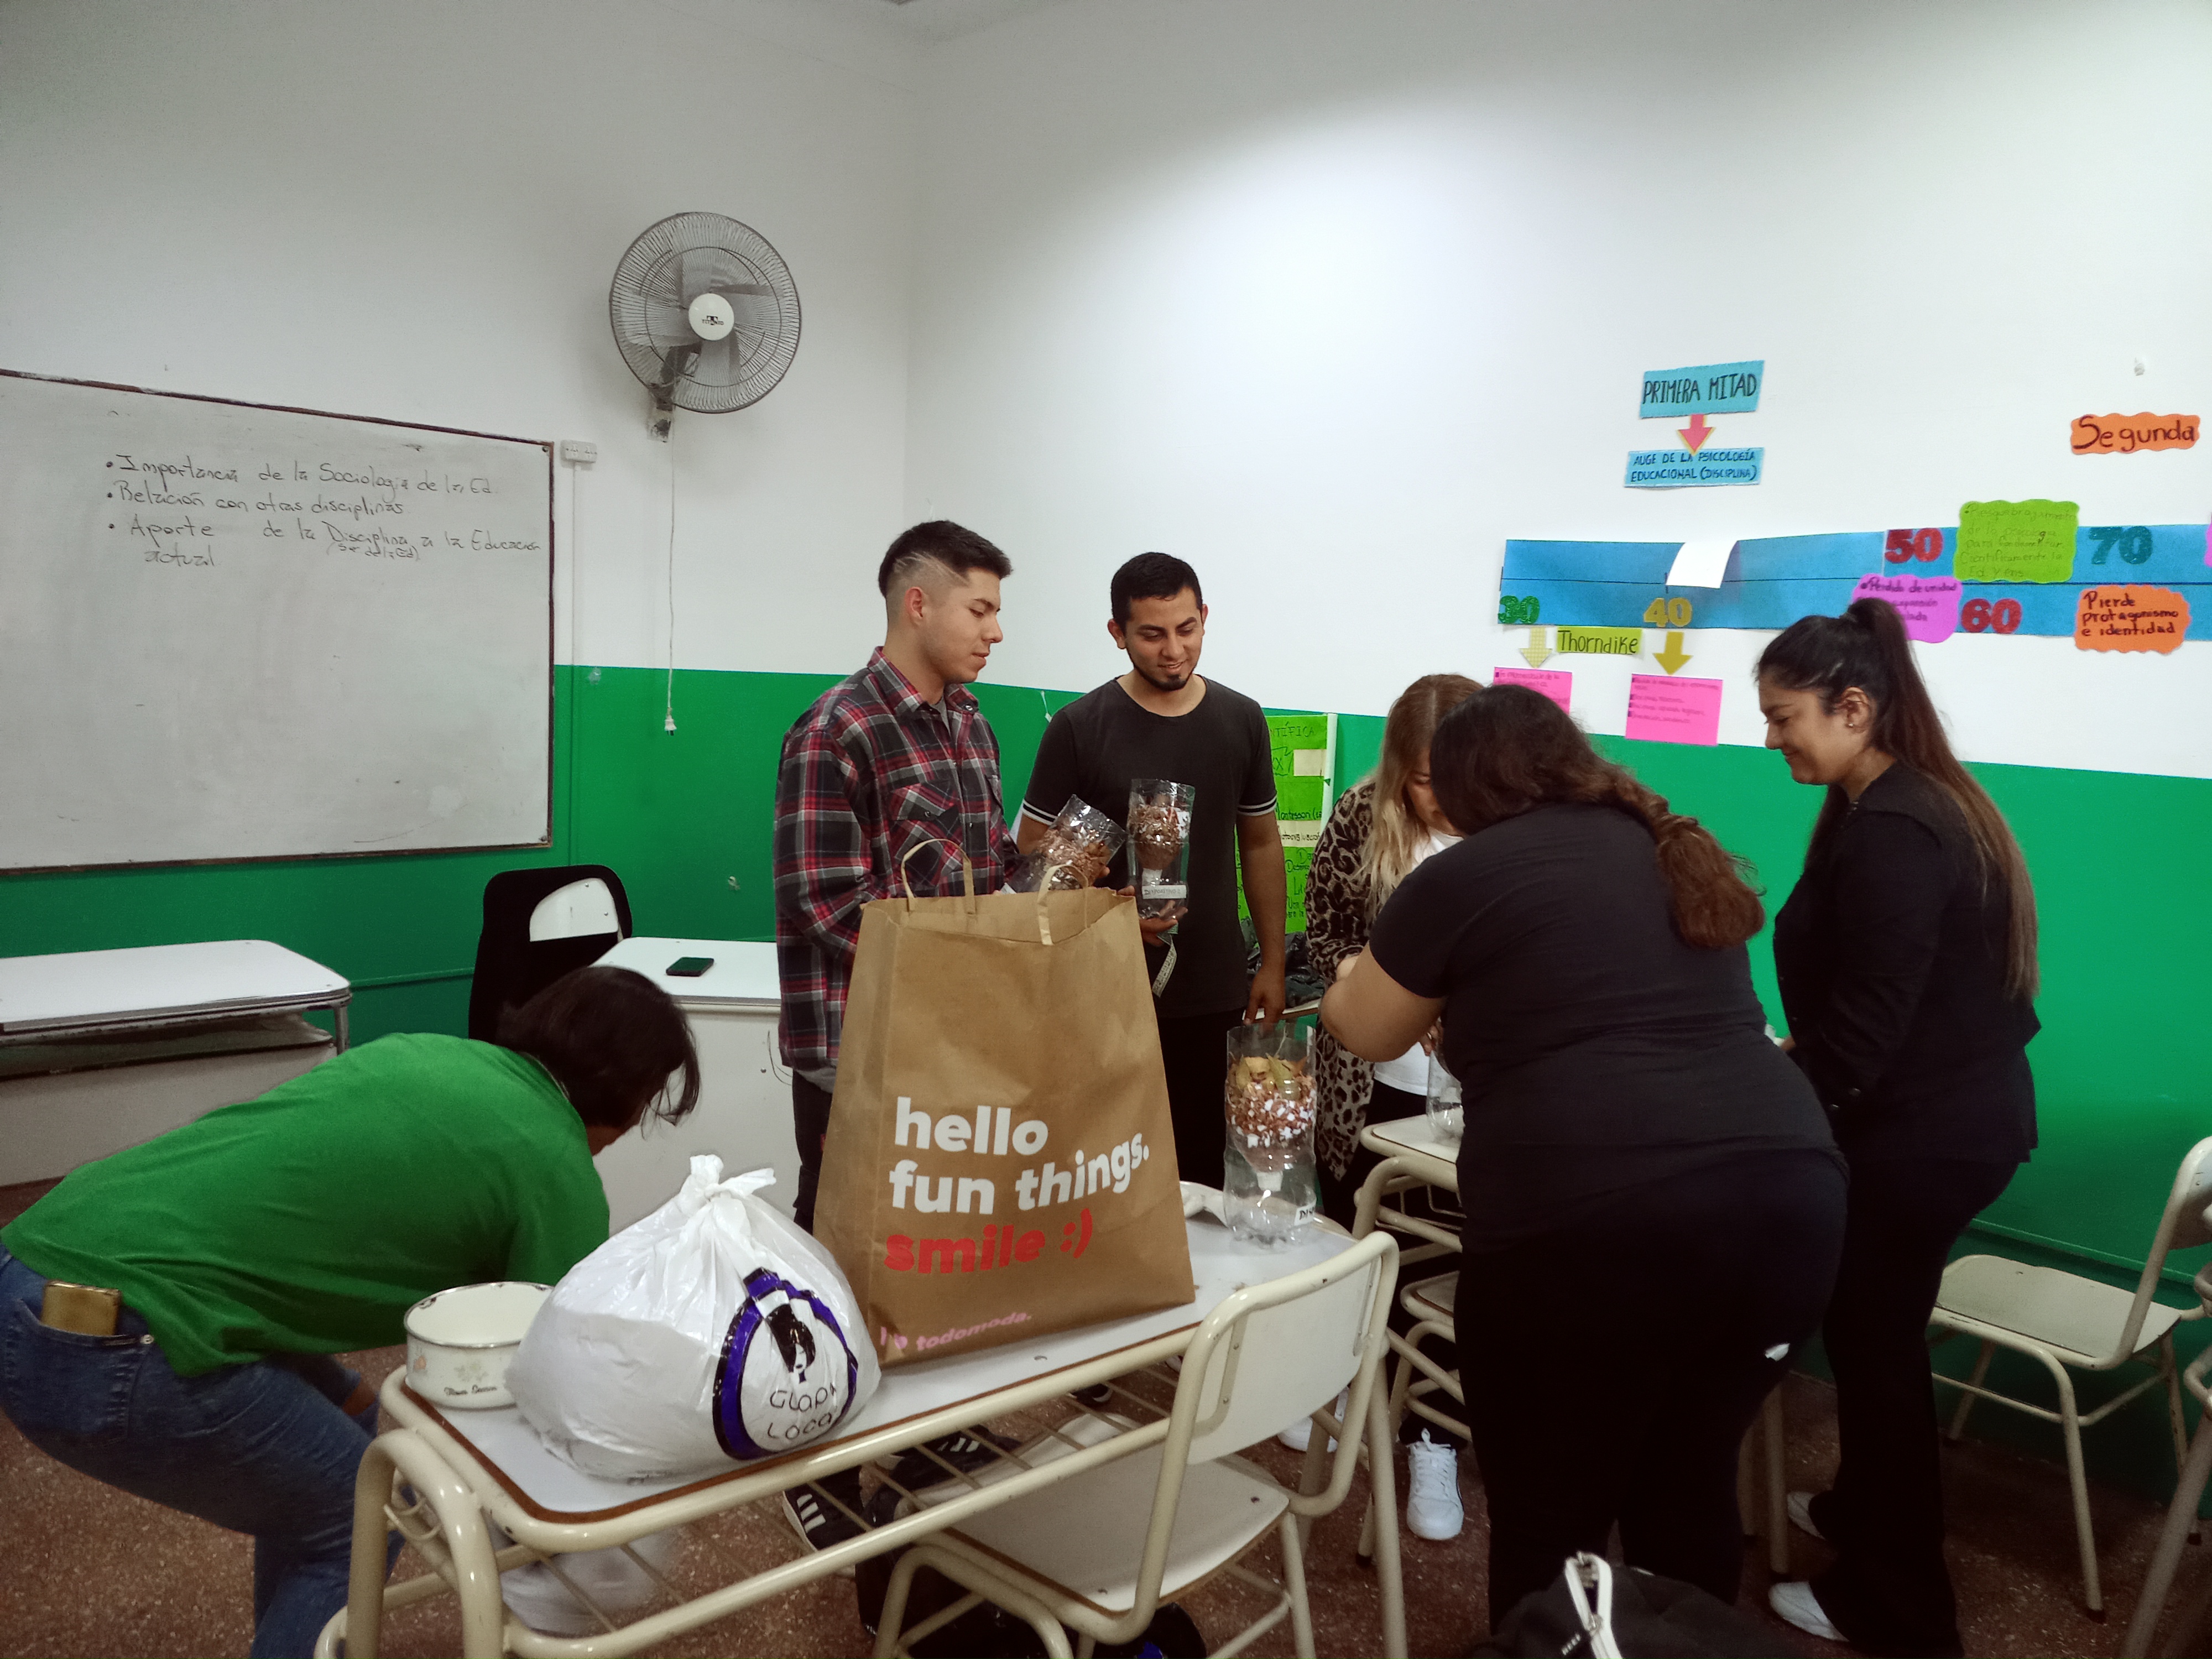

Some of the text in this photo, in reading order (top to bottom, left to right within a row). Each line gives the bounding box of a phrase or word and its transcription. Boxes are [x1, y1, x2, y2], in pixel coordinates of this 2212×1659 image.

[1642, 373, 1757, 404] PRIMERA MITAD
[2072, 415, 2196, 452] Segunda
[1631, 465, 1757, 482] EDUCACIONAL (DISCIPLINA)
[1633, 453, 1656, 466] AUGE
[1662, 452, 1675, 464] DE
[1680, 452, 1693, 462] LA
[258, 463, 285, 480] de
[294, 460, 308, 481] la
[416, 469, 438, 491] de
[215, 498, 249, 513] con
[256, 492, 304, 512] otras
[131, 513, 215, 548] Aporte
[263, 519, 285, 538] de
[297, 517, 316, 540] la
[420, 536, 434, 547] a
[444, 530, 465, 549] la
[1884, 528, 1943, 565] 50
[2088, 525, 2153, 565] 70
[1498, 594, 1540, 625] 30
[1643, 597, 1693, 628] 40
[2084, 590, 2136, 608] Pierde
[1960, 597, 2022, 634] 60
[2081, 619, 2176, 637] e identidad
[1557, 630, 1639, 655] Thorndike
[894, 1096, 1049, 1156] hello
[889, 1133, 1149, 1215] fun things.
[884, 1224, 1046, 1274] smile
